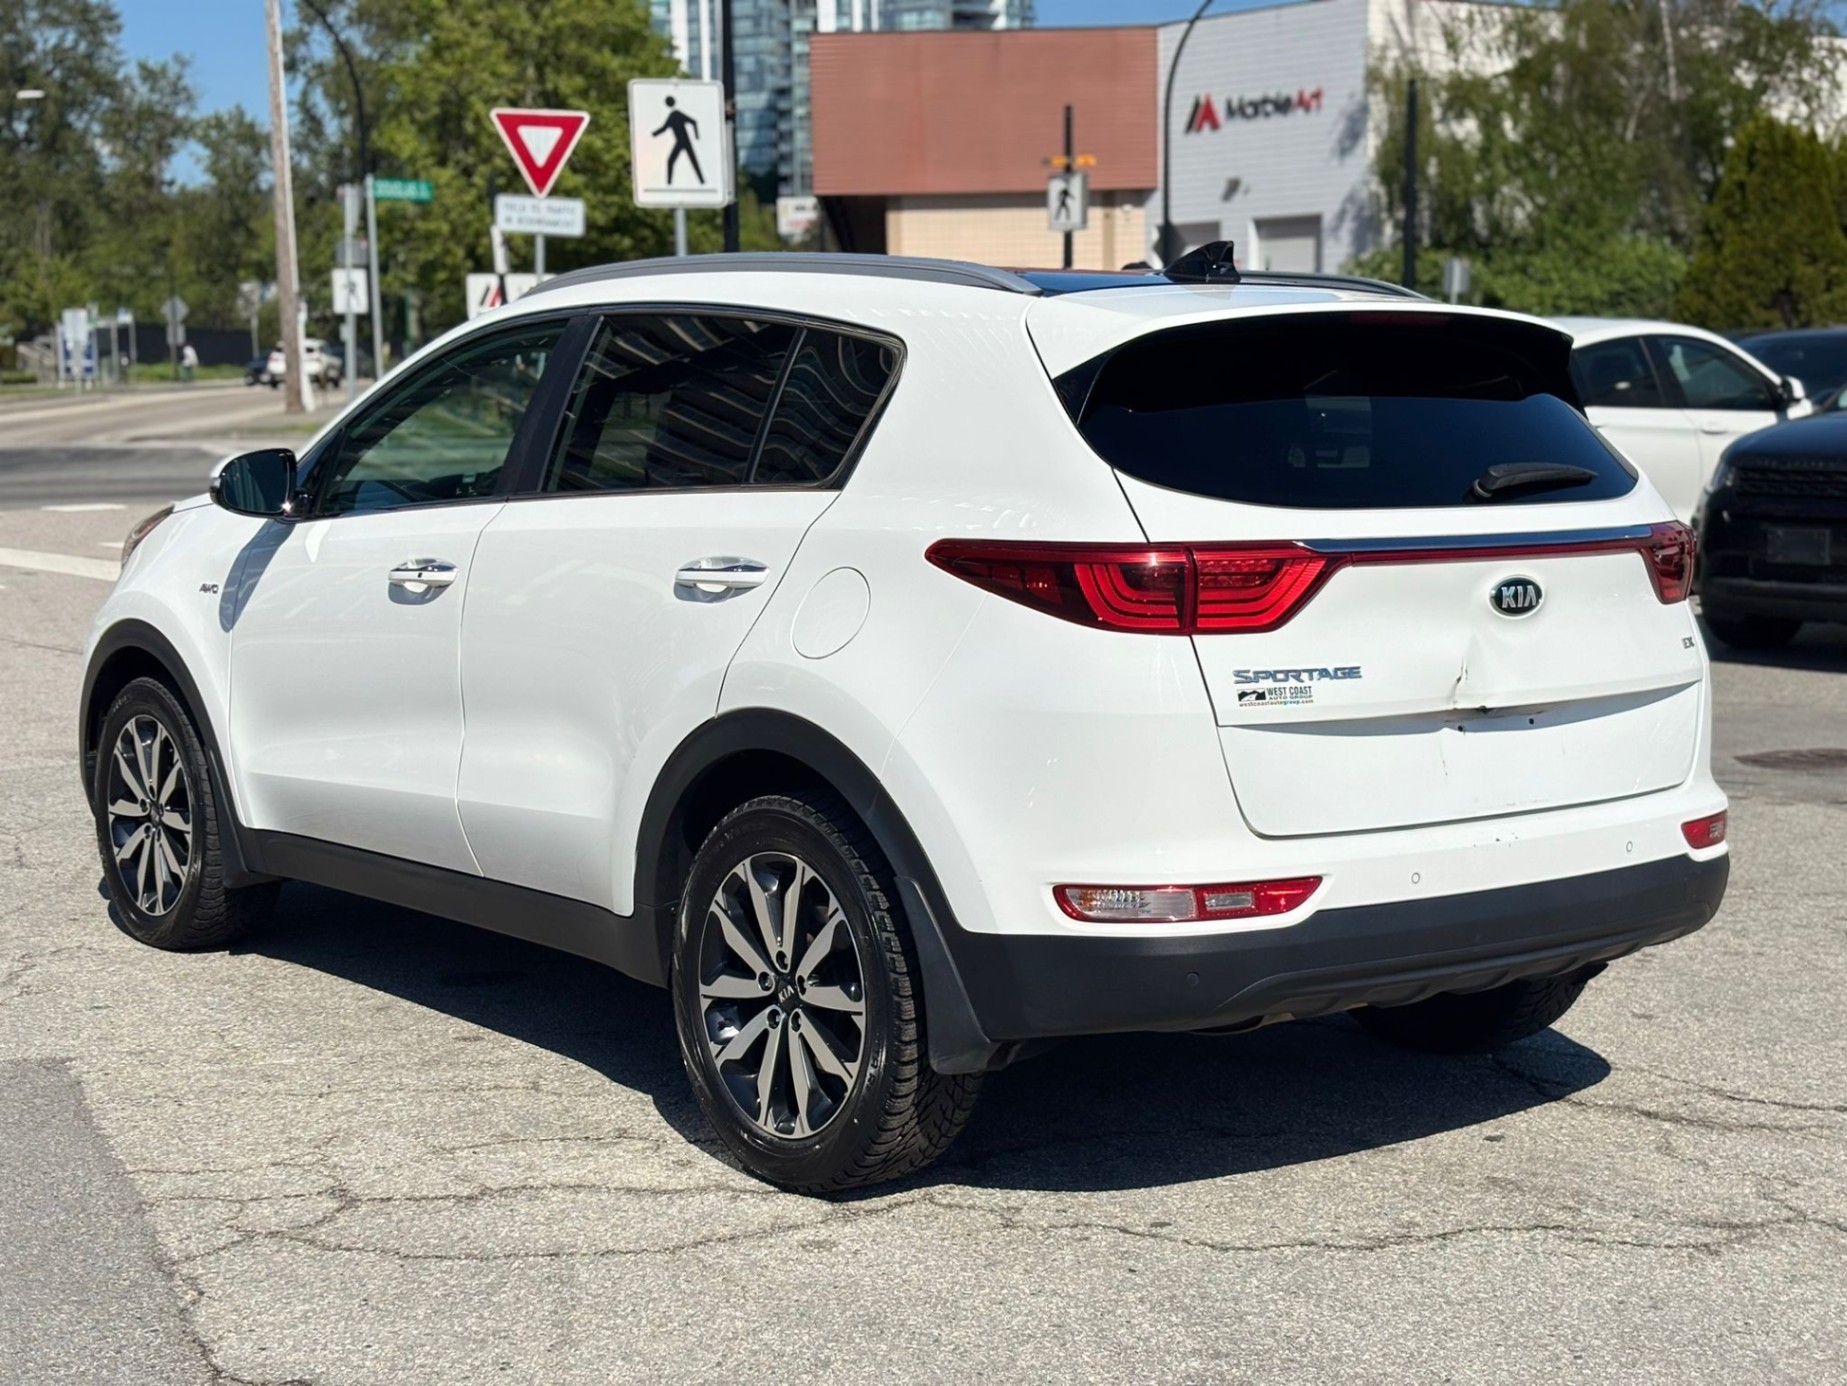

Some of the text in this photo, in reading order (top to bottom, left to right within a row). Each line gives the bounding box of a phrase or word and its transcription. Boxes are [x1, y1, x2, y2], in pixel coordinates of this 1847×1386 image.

[1501, 585, 1537, 608] KIA
[1232, 666, 1362, 684] SPORTAGE
[1266, 686, 1312, 696] WEST COAST
[778, 985, 795, 1003] KIA
